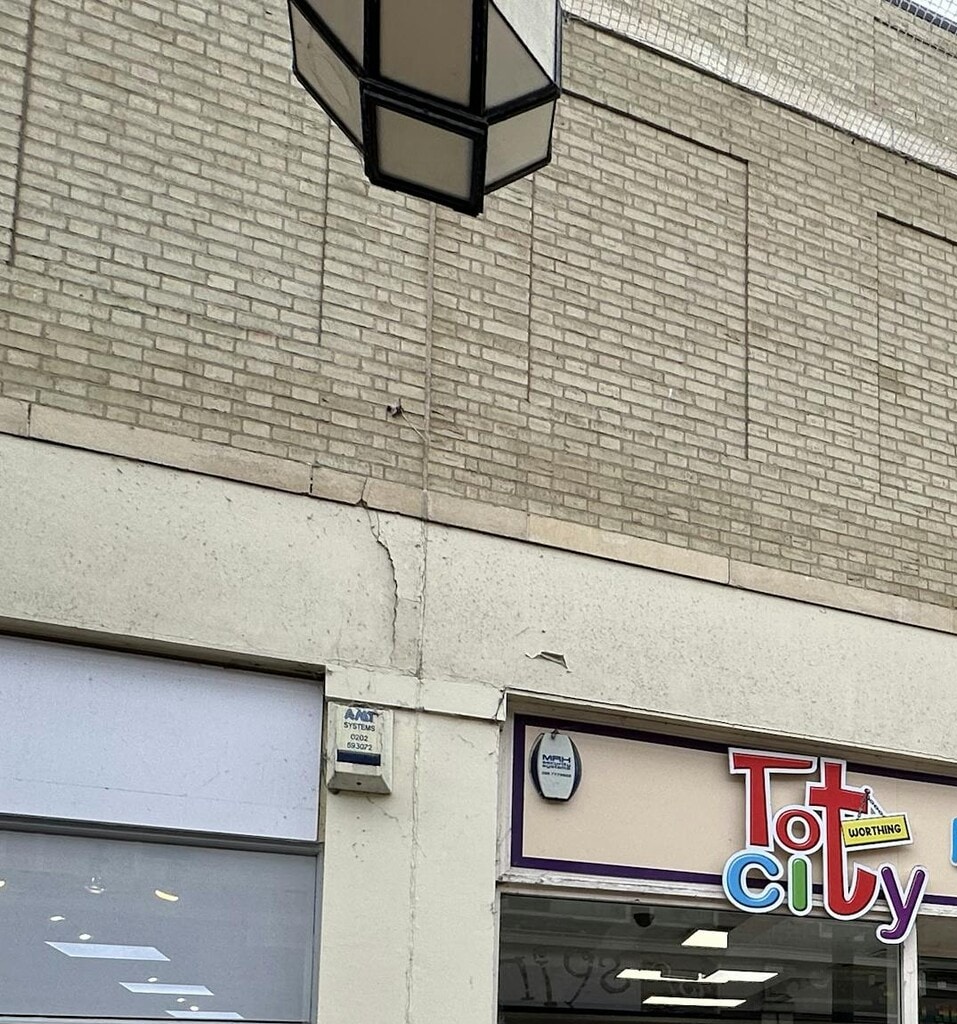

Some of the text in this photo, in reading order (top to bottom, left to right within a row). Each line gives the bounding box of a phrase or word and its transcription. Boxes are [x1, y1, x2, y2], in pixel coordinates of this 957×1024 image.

[343, 721, 376, 732] SYSTEMS
[350, 733, 369, 742] 0202
[847, 823, 902, 839] WORTHING
